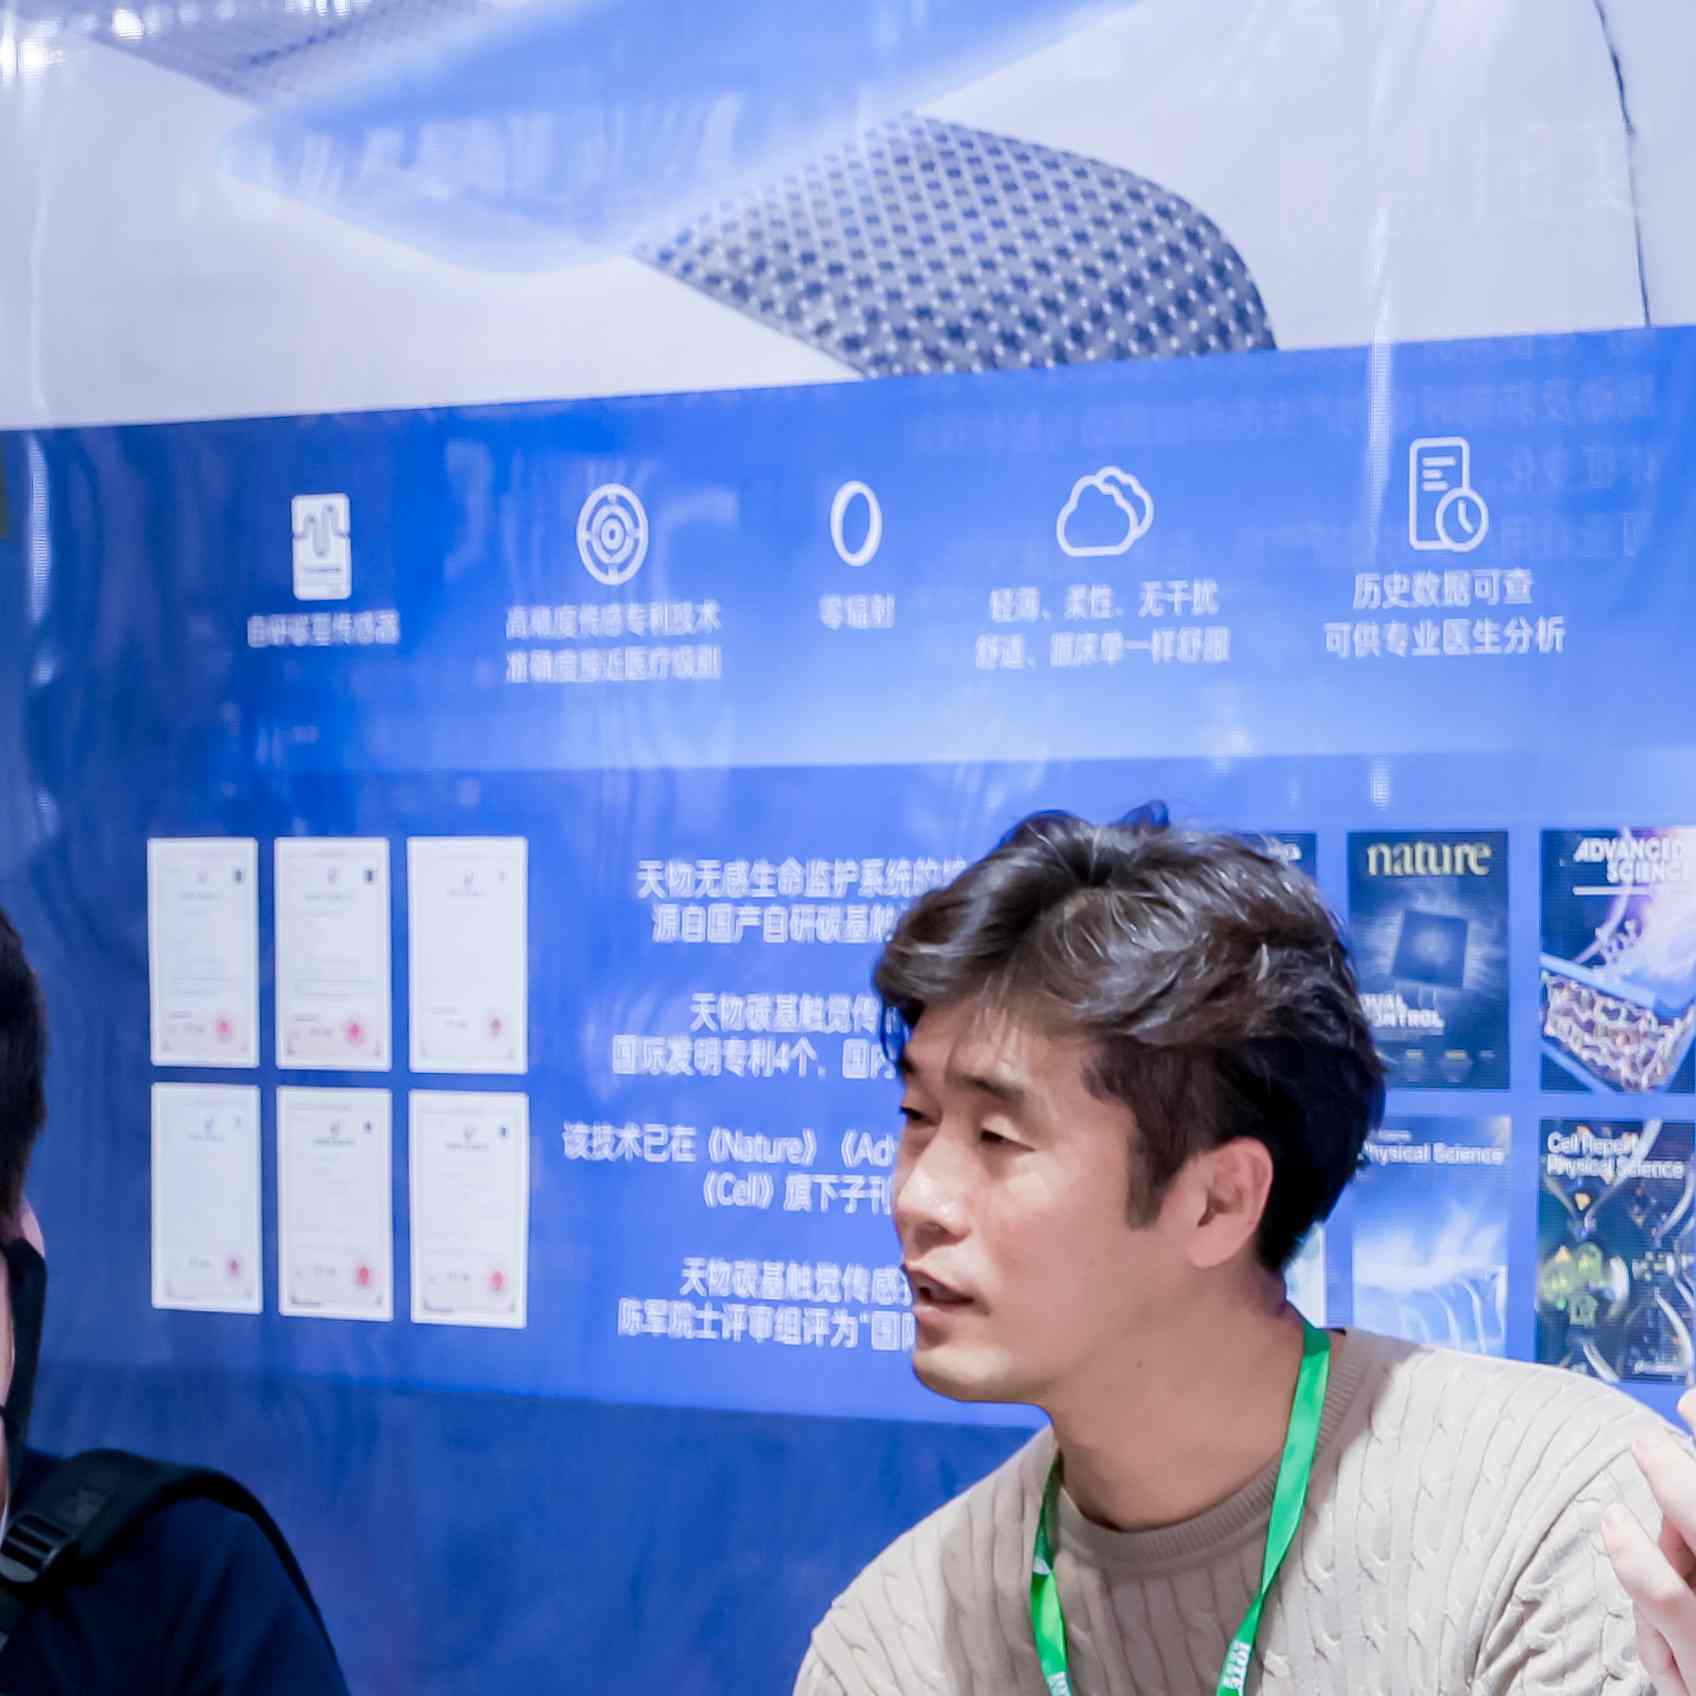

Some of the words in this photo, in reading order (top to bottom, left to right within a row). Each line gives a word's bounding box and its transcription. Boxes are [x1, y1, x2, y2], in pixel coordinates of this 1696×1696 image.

[1353, 568, 1534, 610] 历史数据可查
[1323, 615, 1568, 660] 可供专业医生分析
[1367, 840, 1492, 877] nature
[653, 902, 900, 944] 源自国产自研碳基触
[679, 1256, 913, 1308] 天物碳基触觉传感
